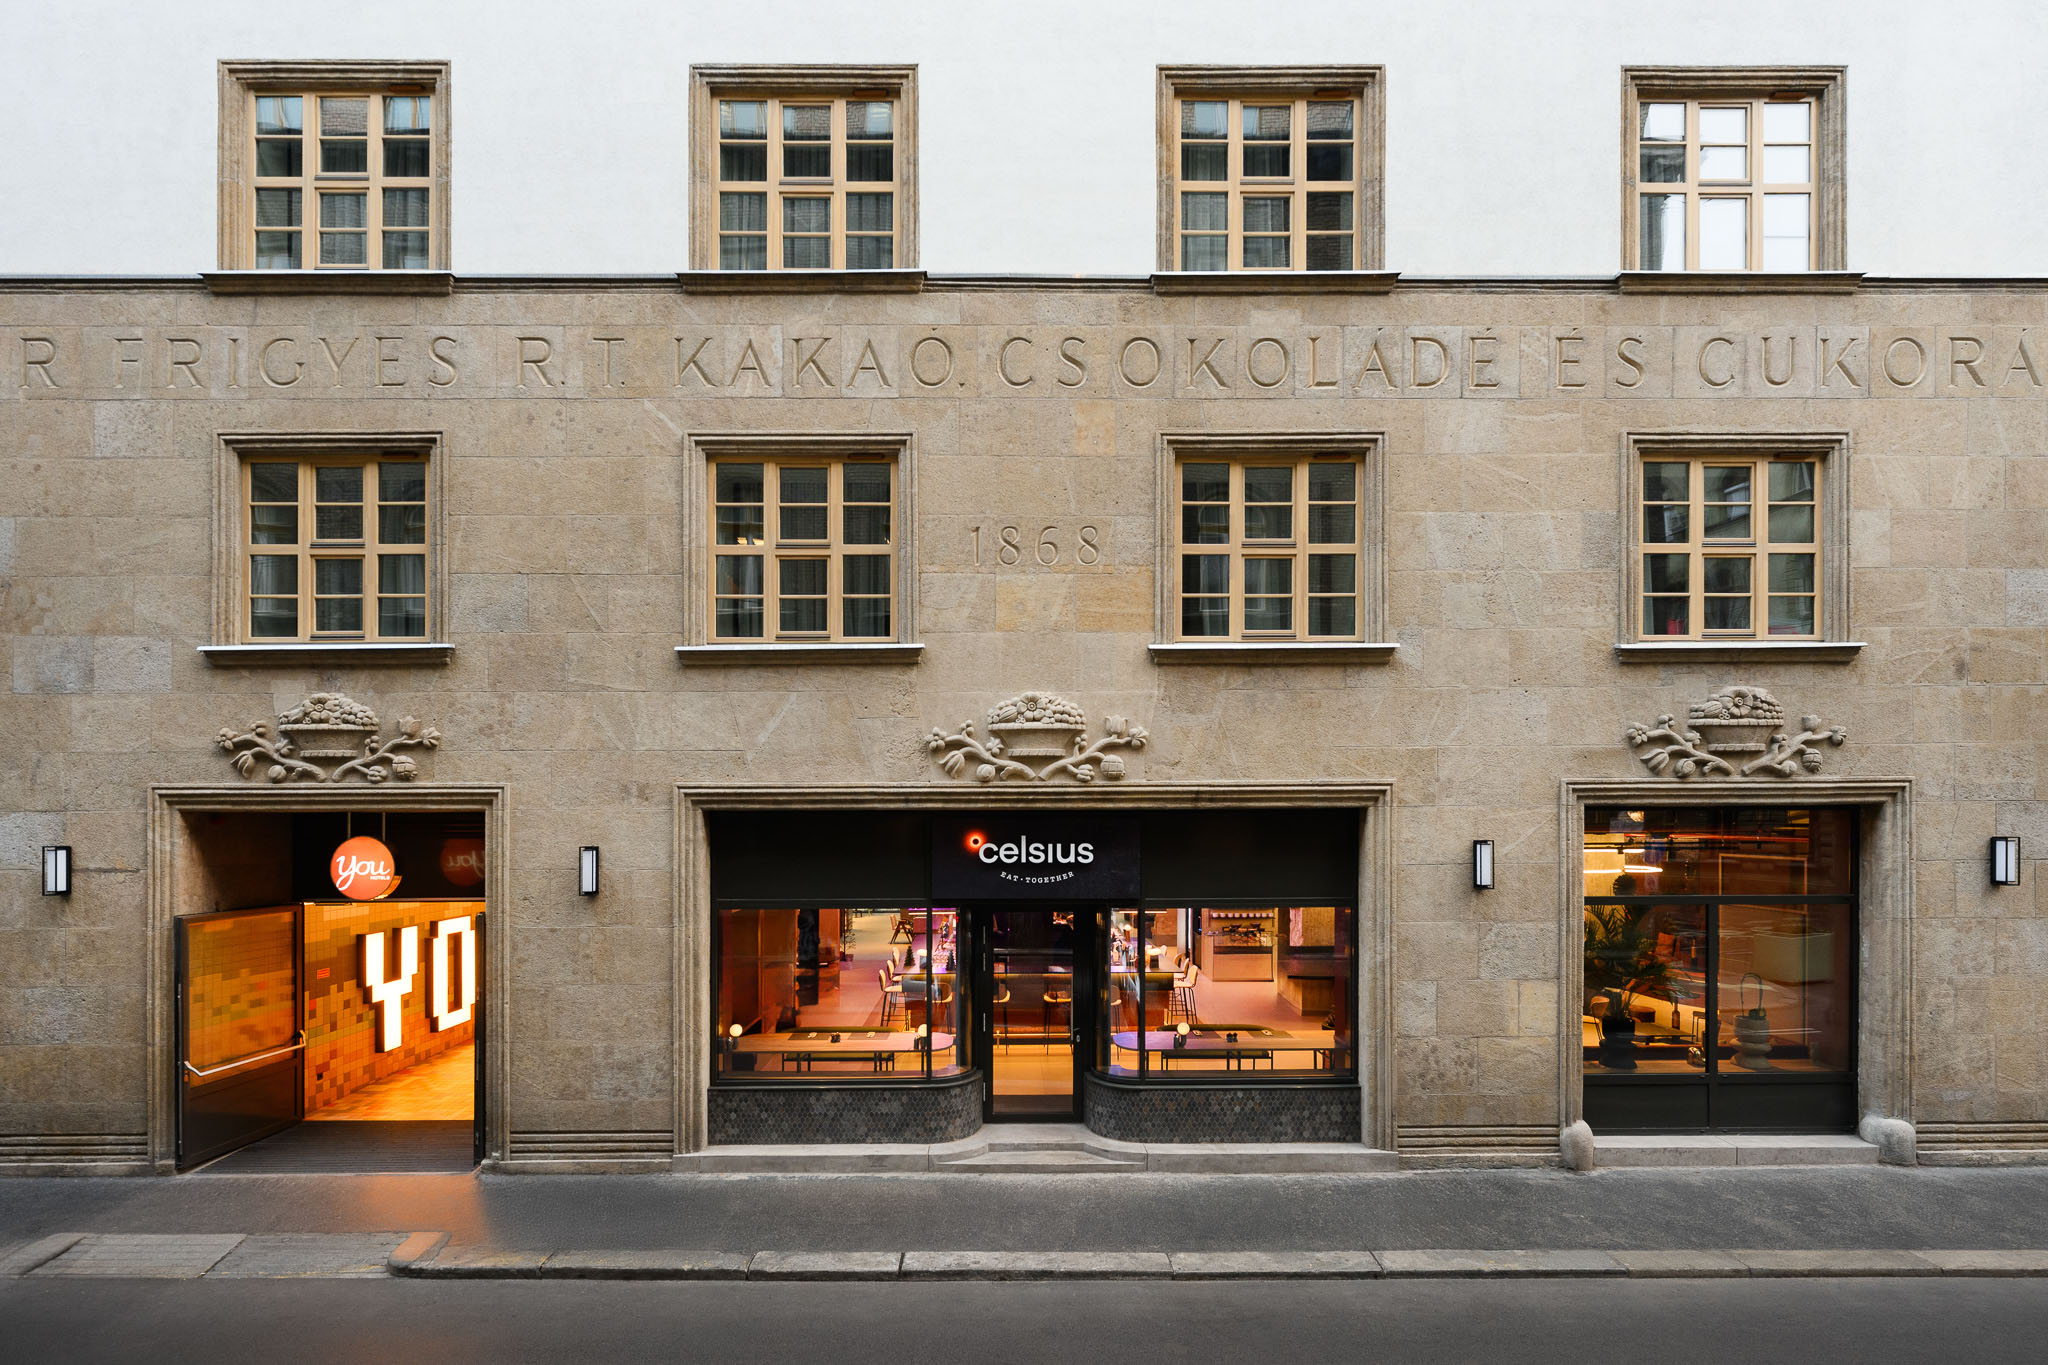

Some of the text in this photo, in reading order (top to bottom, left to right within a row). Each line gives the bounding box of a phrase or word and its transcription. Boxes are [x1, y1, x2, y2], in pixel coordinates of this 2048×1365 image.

[18, 337, 60, 388] R
[113, 336, 460, 388] FRIGYES
[996, 328, 1501, 390] CSOKOLÁDÉ
[1555, 327, 1646, 389] ÉS
[1697, 328, 2044, 389] CUKORÁ
[970, 525, 1100, 566] 1868
[1025, 871, 1075, 884] TOGETHER
